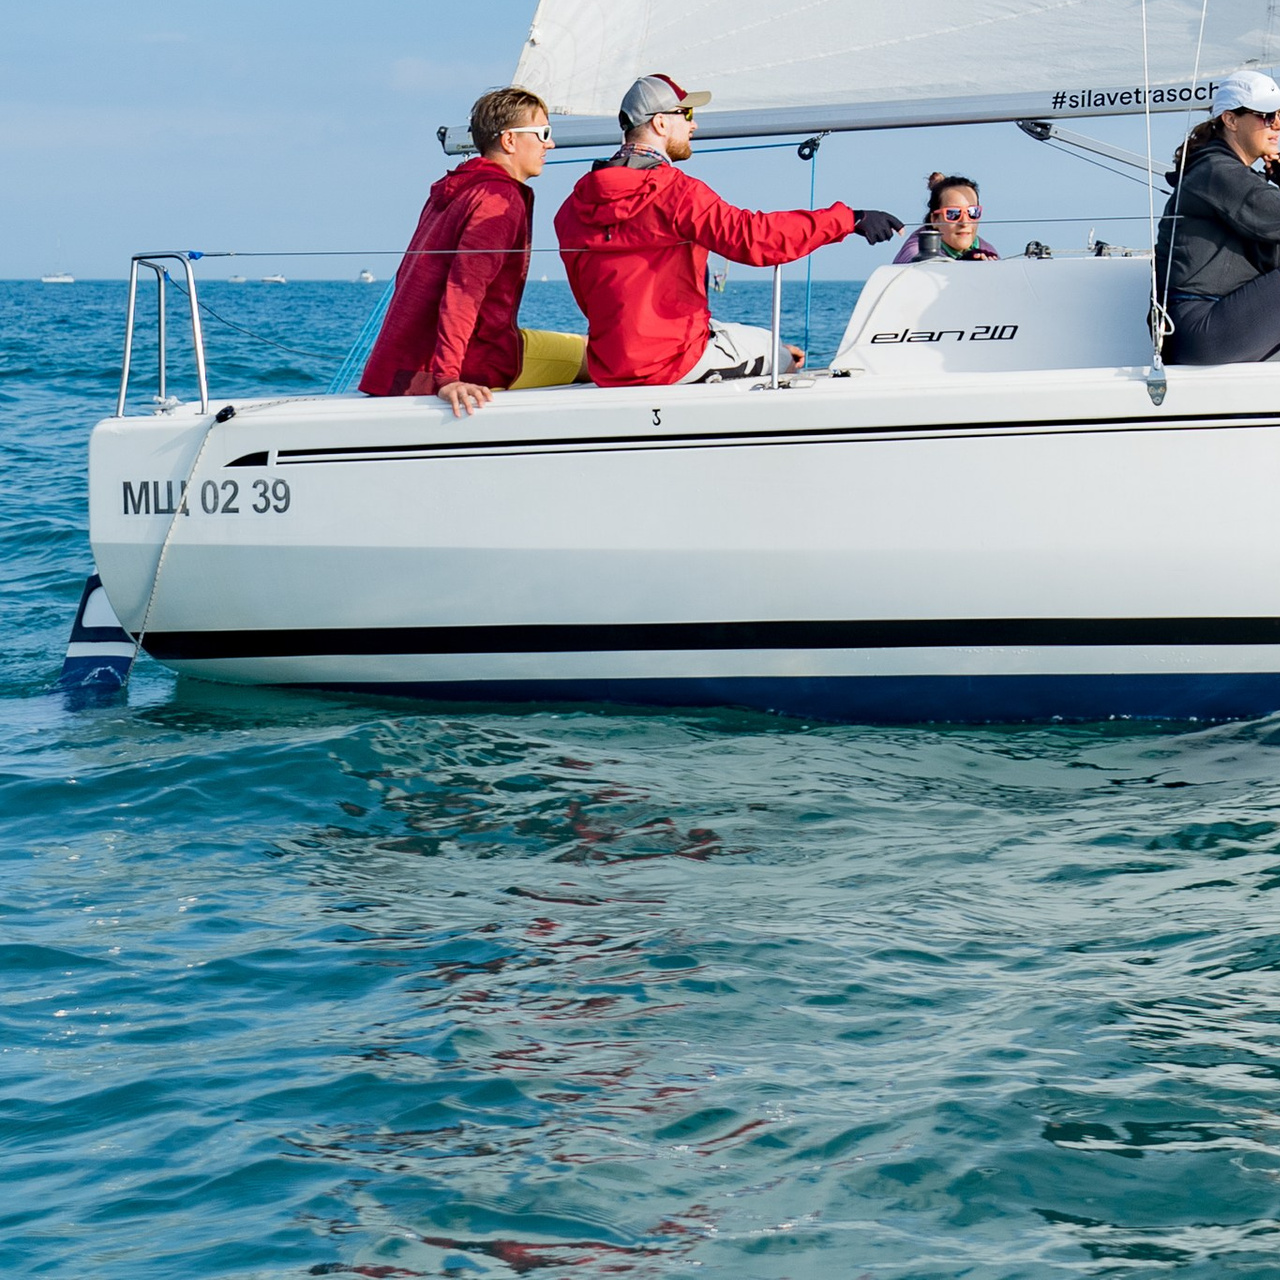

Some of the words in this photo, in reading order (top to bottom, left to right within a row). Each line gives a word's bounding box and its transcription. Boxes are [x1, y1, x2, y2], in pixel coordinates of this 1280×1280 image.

[871, 328, 965, 343] elan
[969, 325, 1018, 341] 210
[201, 479, 240, 514] 02
[252, 478, 291, 514] 39
